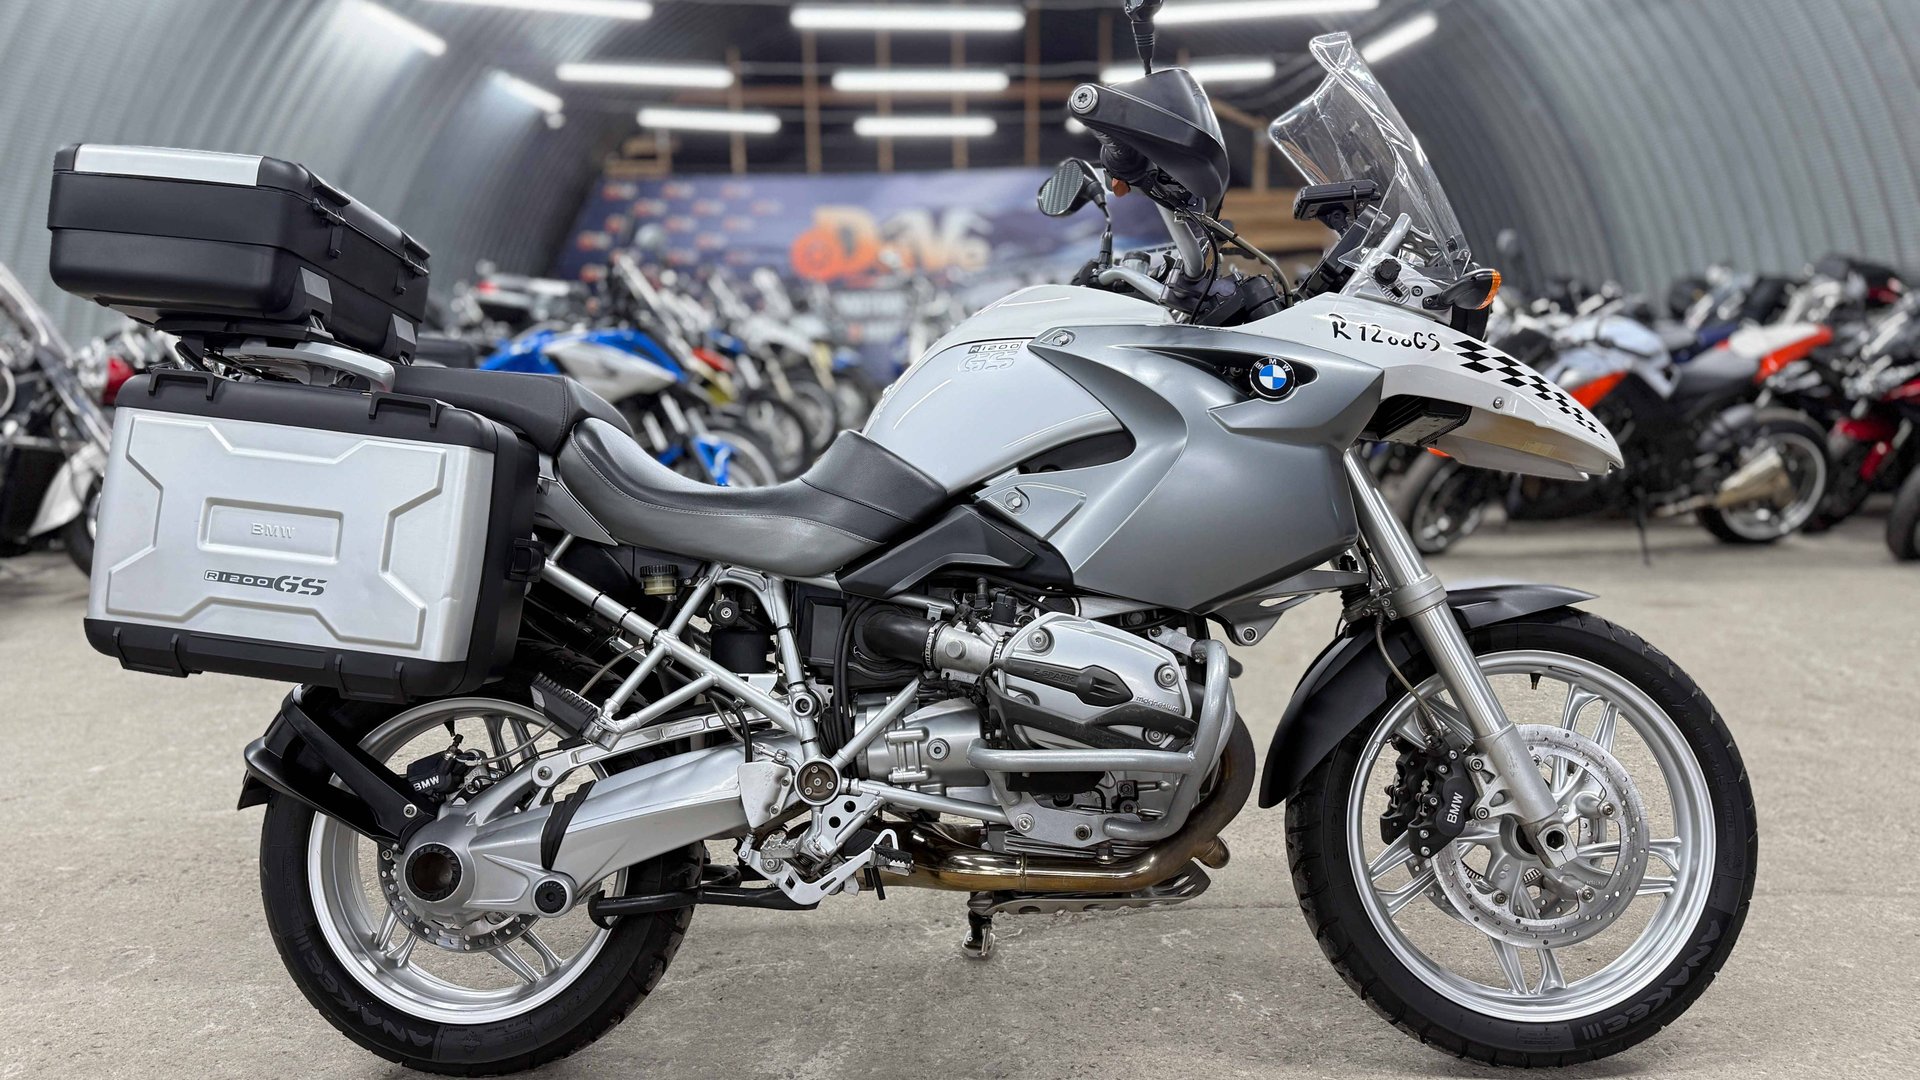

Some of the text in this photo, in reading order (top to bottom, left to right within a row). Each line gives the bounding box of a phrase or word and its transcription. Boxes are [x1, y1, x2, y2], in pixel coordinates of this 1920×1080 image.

[1328, 313, 1352, 340] R
[968, 341, 1023, 354] R1200
[959, 351, 1018, 373] GS
[1254, 358, 1291, 373] BMW
[251, 522, 295, 539] BMW
[1136, 696, 1180, 713] magnesium
[413, 775, 439, 791] BMW
[1447, 792, 1463, 824] BMW
